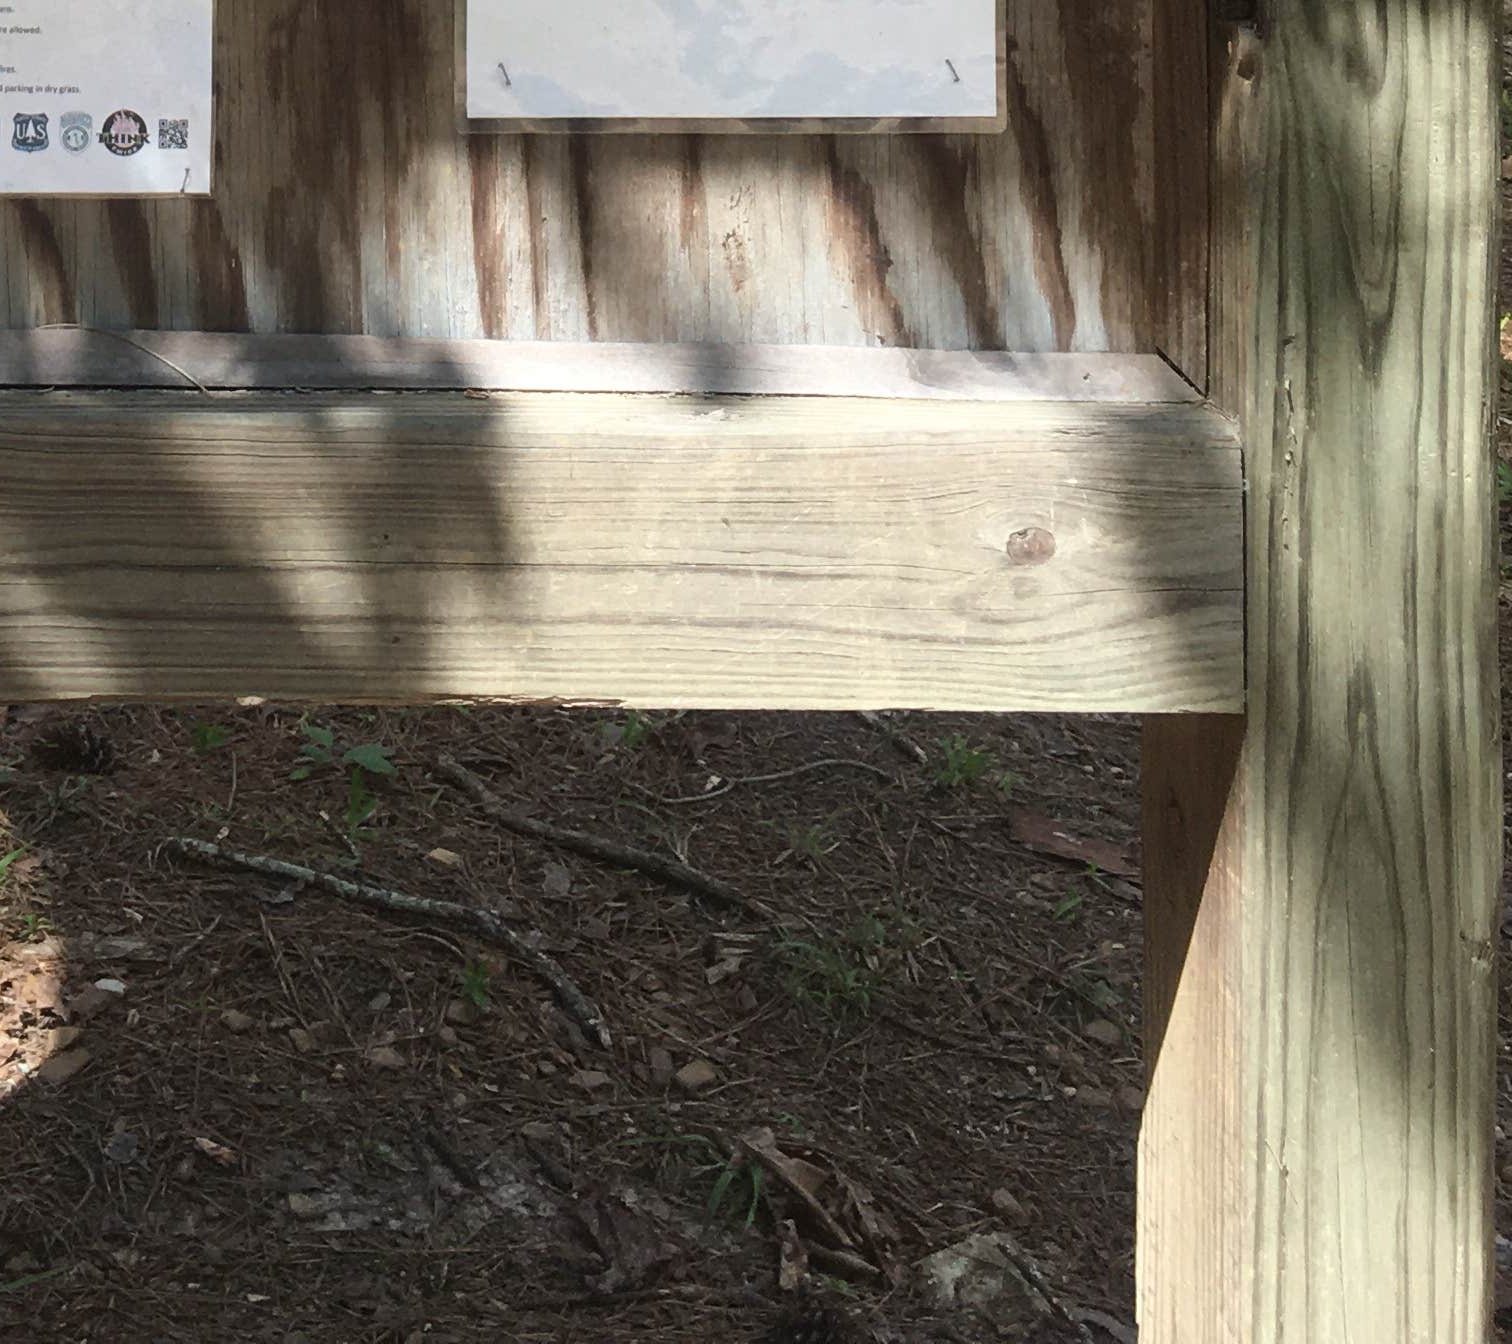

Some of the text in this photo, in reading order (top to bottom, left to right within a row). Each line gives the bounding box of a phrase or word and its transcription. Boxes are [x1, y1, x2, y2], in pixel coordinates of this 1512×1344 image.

[4, 85, 34, 96] parking
[44, 86, 57, 96] dry
[97, 133, 150, 144] THINK
